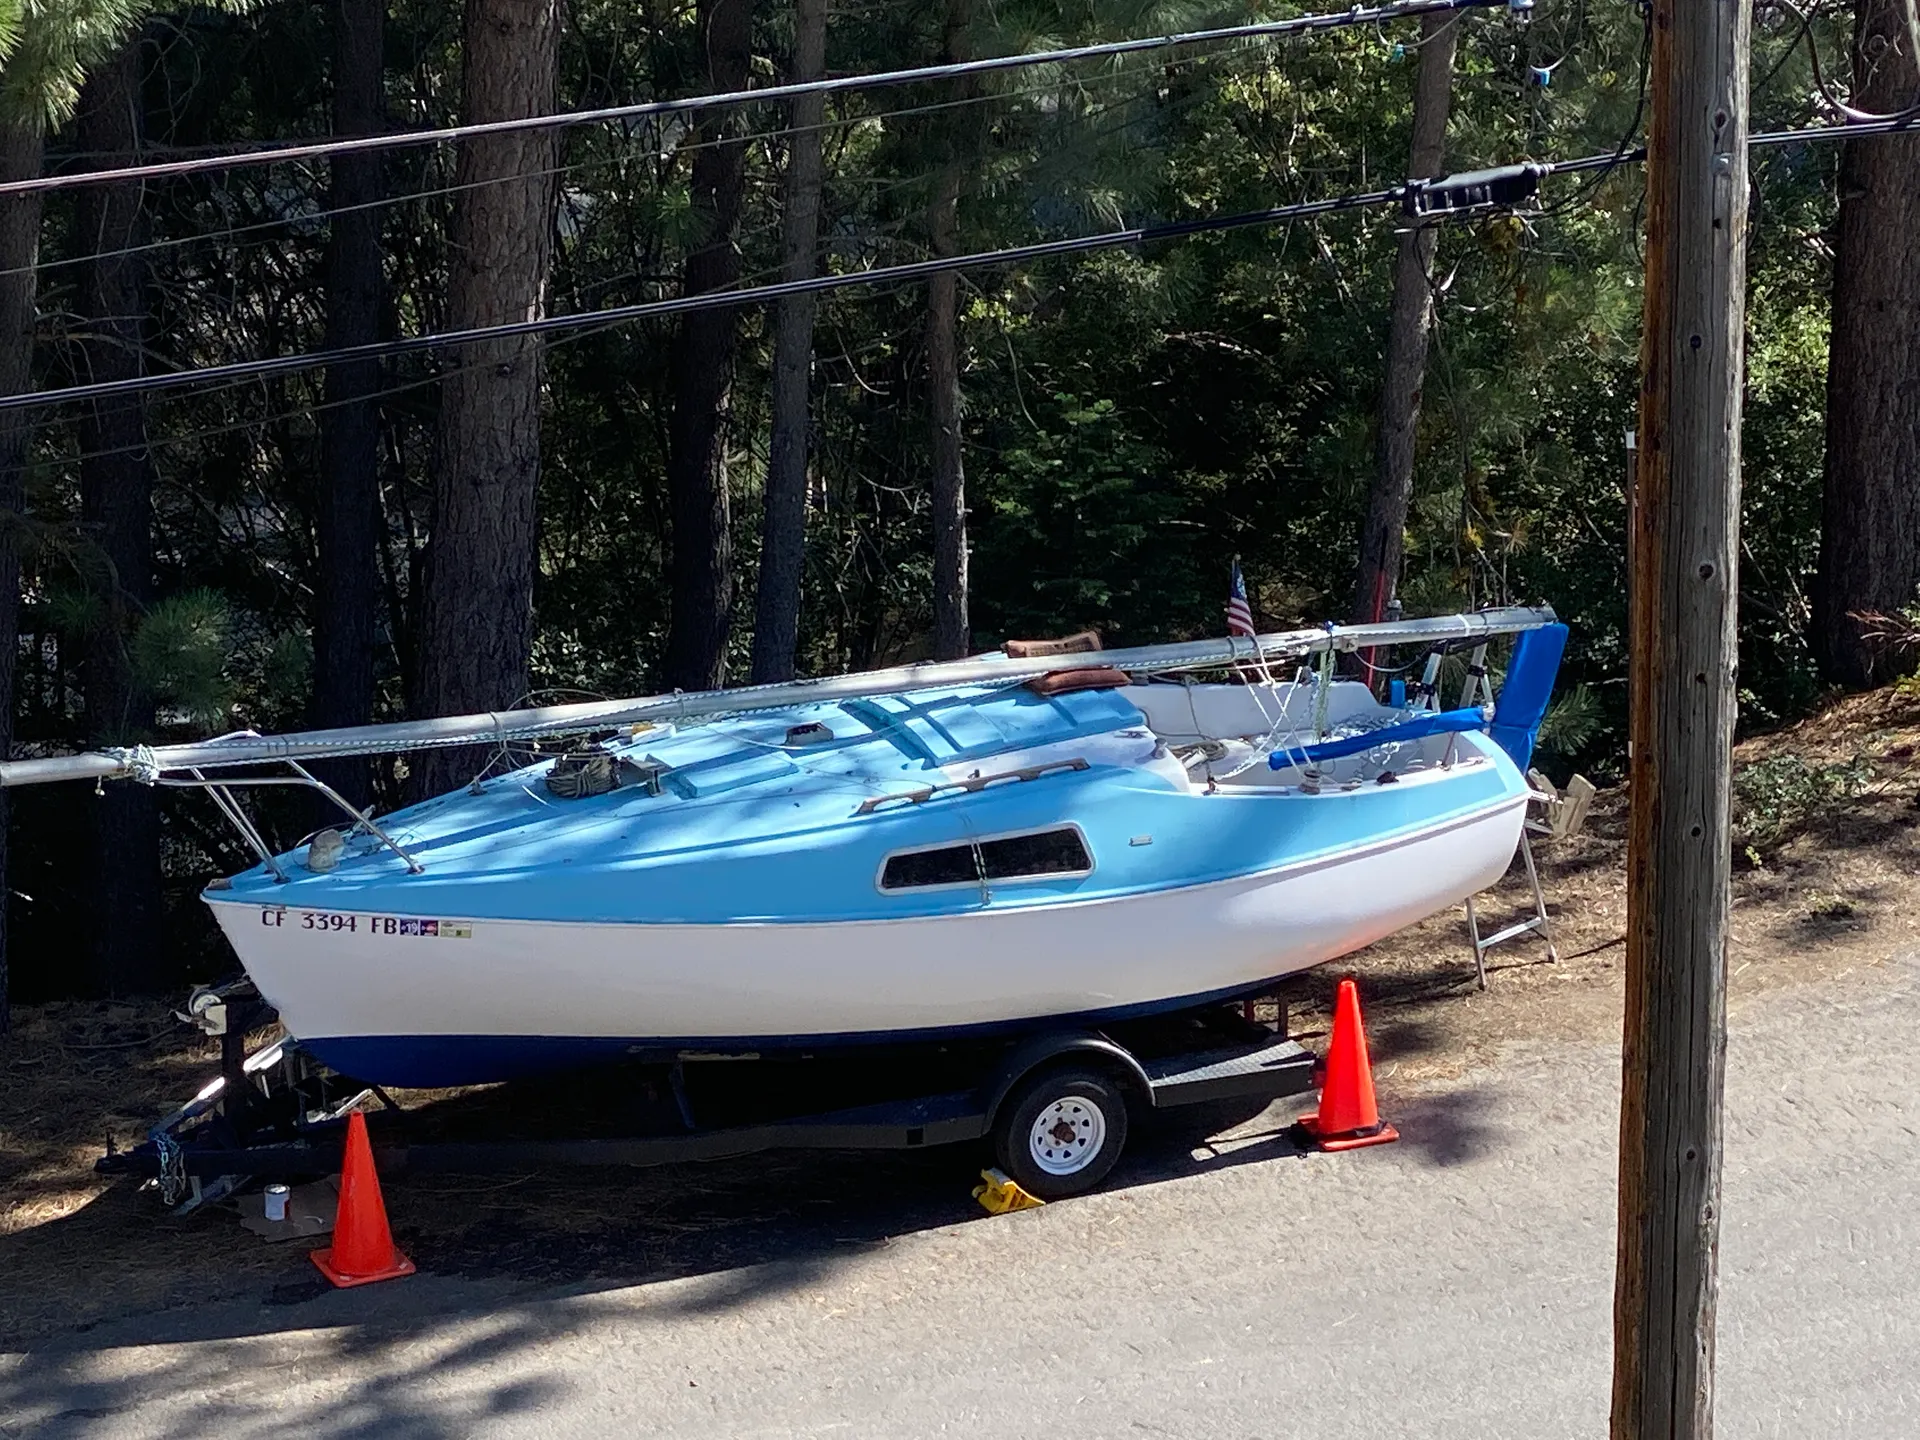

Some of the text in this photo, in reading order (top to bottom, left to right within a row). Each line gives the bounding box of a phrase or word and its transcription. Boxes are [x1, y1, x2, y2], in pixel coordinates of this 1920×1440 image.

[261, 909, 397, 935] CF 3394 FB
